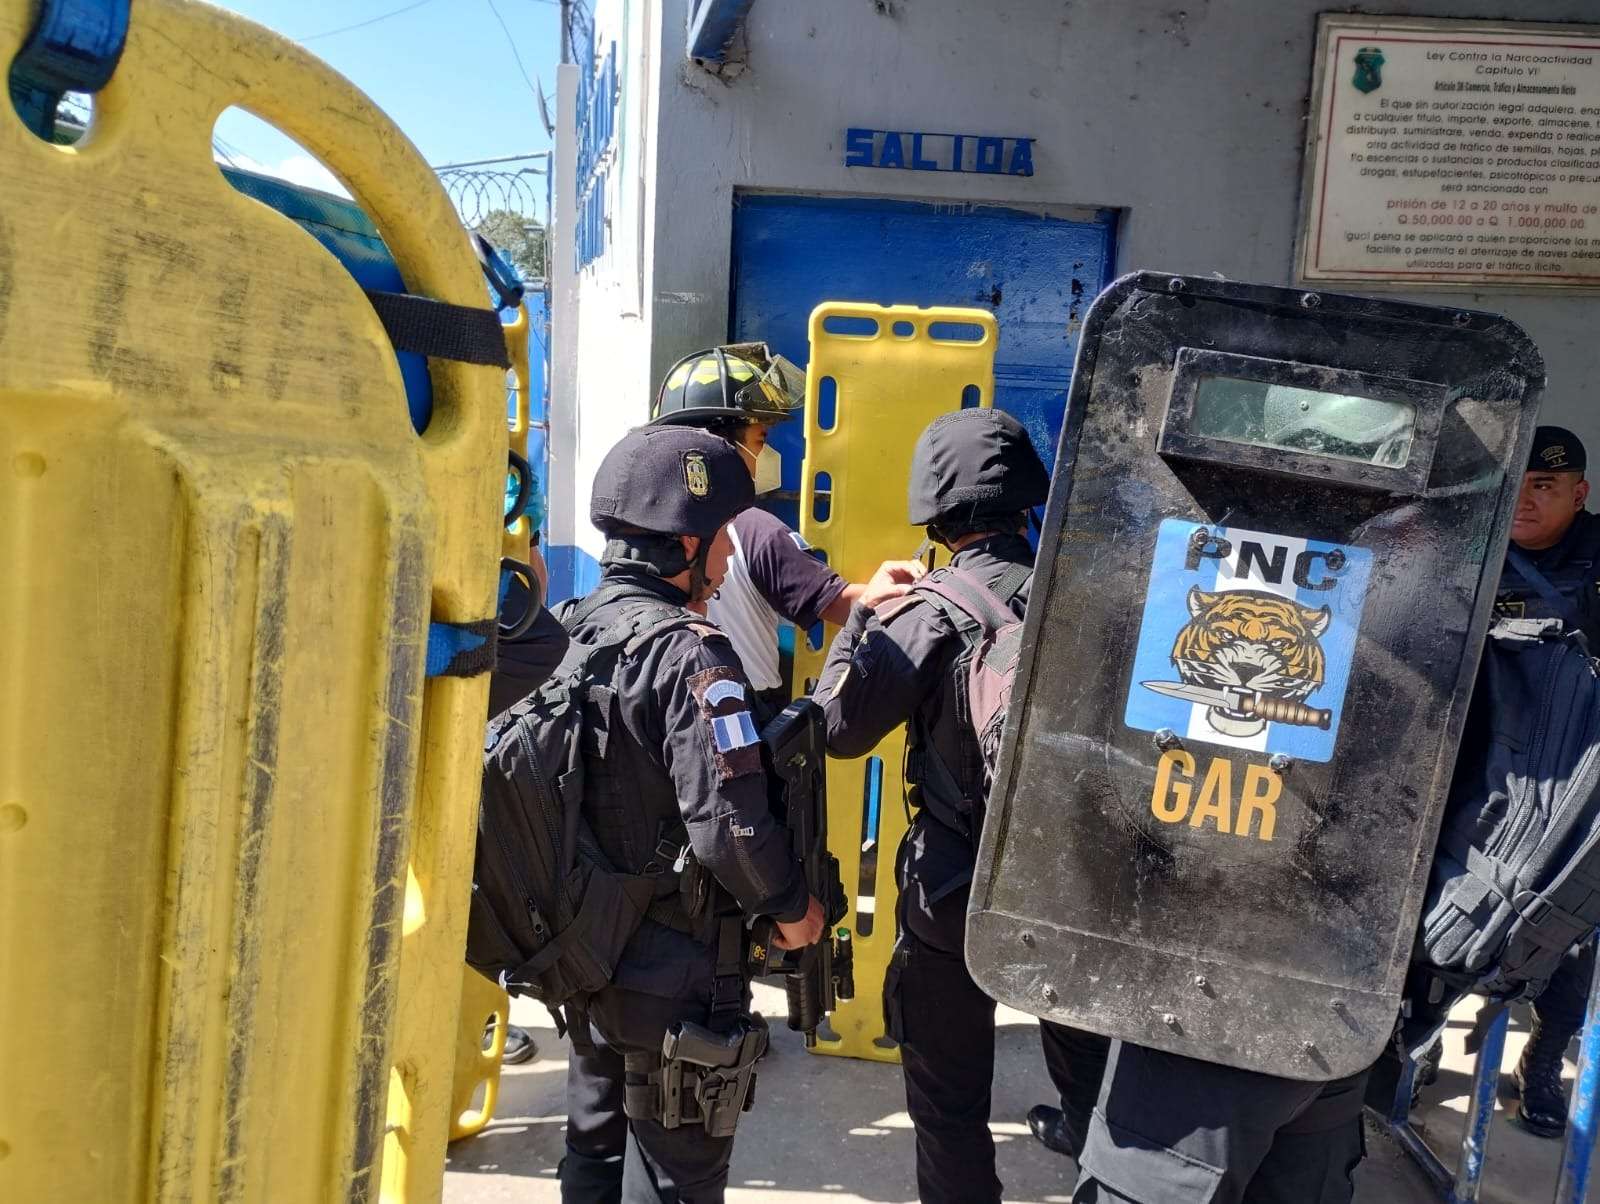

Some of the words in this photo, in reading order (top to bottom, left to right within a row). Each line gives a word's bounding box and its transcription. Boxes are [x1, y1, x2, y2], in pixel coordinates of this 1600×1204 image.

[1426, 51, 1445, 62] Ley
[1449, 52, 1487, 62] Contra
[1492, 53, 1502, 62] la
[1506, 53, 1593, 65] Narcoactividad
[1392, 100, 1412, 110] que
[1416, 100, 1428, 109] sin
[1498, 101, 1524, 113] legal
[1353, 113, 1361, 121] a
[1364, 112, 1414, 122] cualquier
[846, 128, 1036, 176] SALIDA
[1390, 140, 1440, 150] actividad
[1442, 142, 1457, 151] de
[1496, 143, 1509, 152] de
[1422, 156, 1430, 164] o
[1496, 157, 1548, 168] productos
[1560, 174, 1566, 182] o
[1466, 184, 1526, 194] sancionado
[1529, 186, 1548, 194] con
[1430, 200, 1447, 210] de
[1453, 200, 1466, 210] 12
[1470, 202, 1478, 210] a
[1482, 200, 1498, 211] 20
[1534, 204, 1540, 214] y
[1544, 202, 1578, 214] multa
[1582, 204, 1598, 214] de
[1476, 217, 1484, 226] a
[1373, 232, 1401, 242] pena
[1404, 232, 1416, 242] se
[1466, 234, 1474, 242] a
[1574, 236, 1588, 246] los
[1404, 246, 1412, 254] o
[1414, 246, 1455, 256] permita
[1458, 246, 1468, 256] el
[1470, 247, 1518, 258] aterrizaje
[1520, 248, 1535, 258] de
[1538, 250, 1568, 259] naves
[1406, 260, 1454, 269] utilizadas
[1457, 261, 1482, 270] para
[1486, 261, 1496, 270] el
[1184, 528, 1346, 592] PNC
[1151, 749, 1284, 842] GAR
